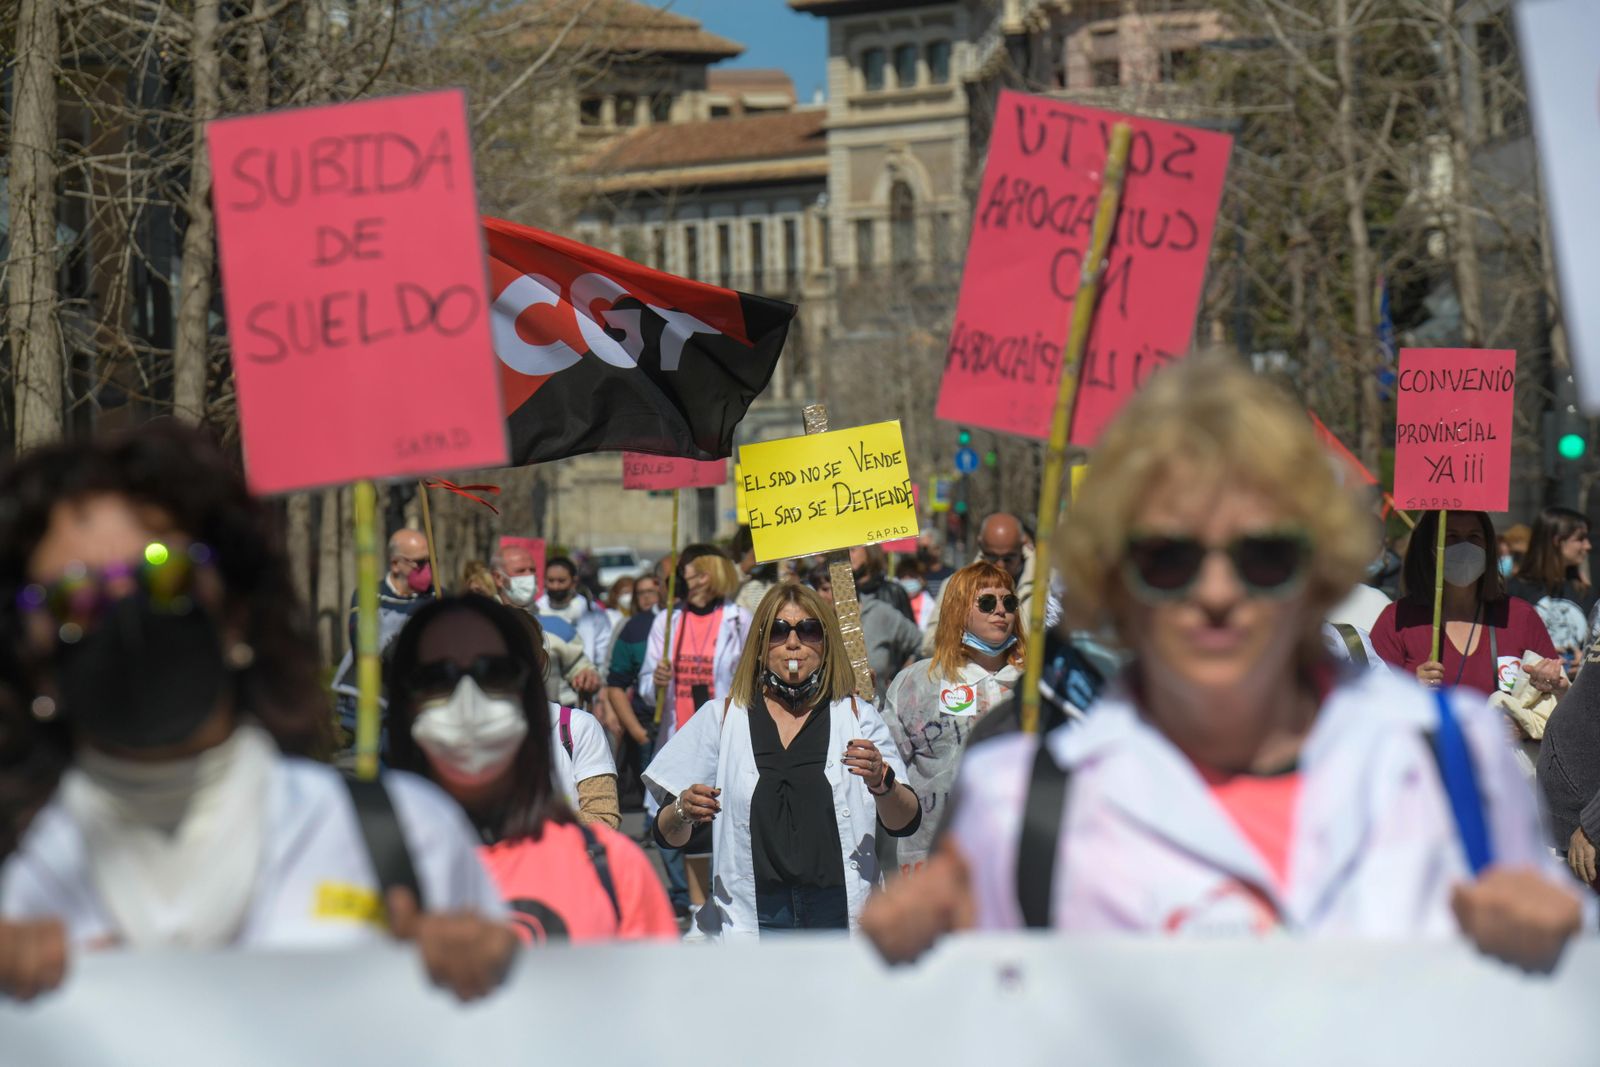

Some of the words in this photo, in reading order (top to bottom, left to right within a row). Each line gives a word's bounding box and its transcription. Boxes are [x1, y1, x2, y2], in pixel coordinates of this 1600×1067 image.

[229, 127, 455, 213] SUBIDA
[311, 216, 386, 268] DE
[245, 280, 482, 365] SUELDO
[492, 272, 722, 376] CGT
[743, 474, 767, 492] EL
[768, 470, 797, 488] SAD
[800, 466, 821, 484] NO
[823, 460, 842, 480] SE
[1424, 454, 1456, 484] YA
[748, 508, 772, 530] EL
[774, 505, 802, 527] SAD
[808, 500, 827, 520] SE
